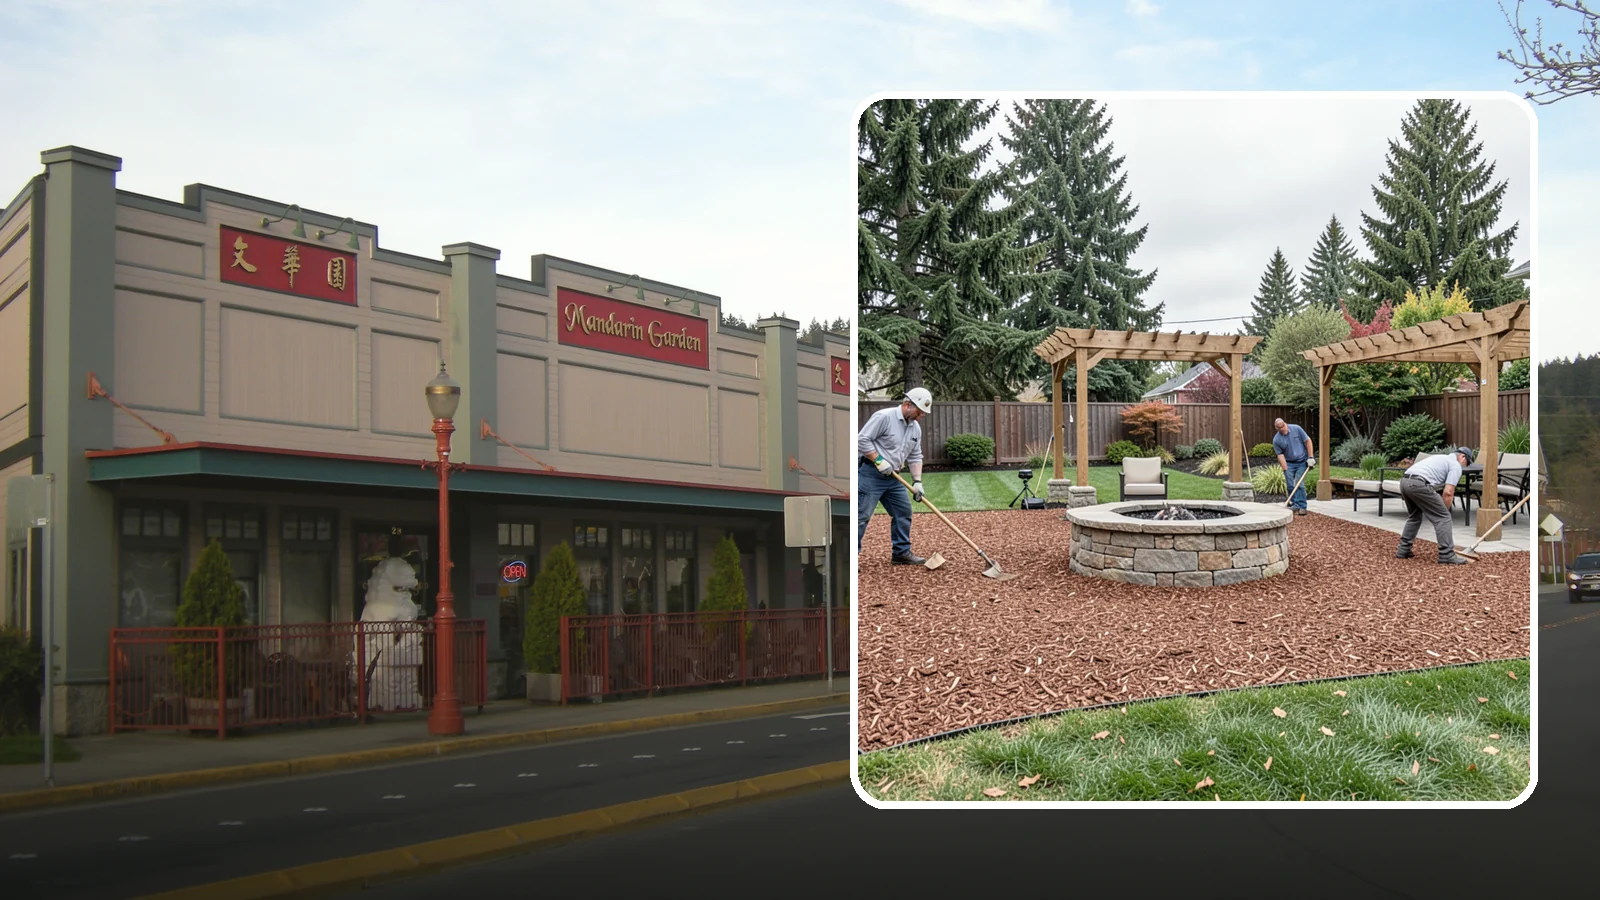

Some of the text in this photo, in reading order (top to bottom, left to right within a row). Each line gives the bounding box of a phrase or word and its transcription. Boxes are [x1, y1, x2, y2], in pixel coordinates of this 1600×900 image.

[231, 237, 347, 290] 文華園
[565, 303, 701, 352] Mandarin Garden
[834, 363, 846, 386] 文
[503, 566, 527, 578] OPEN
